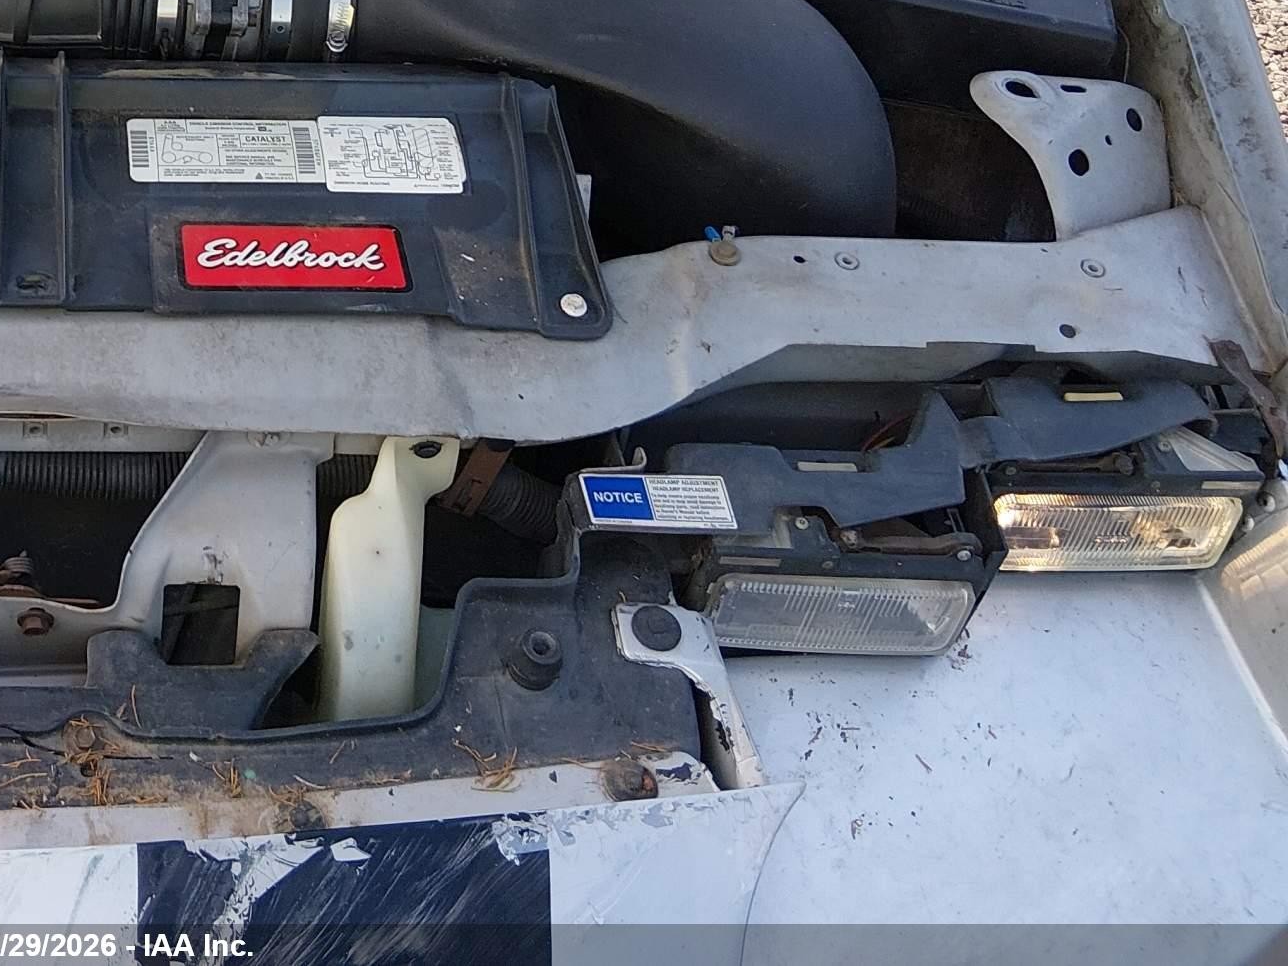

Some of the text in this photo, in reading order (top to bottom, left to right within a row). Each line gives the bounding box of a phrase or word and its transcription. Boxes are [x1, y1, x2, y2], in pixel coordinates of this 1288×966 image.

[244, 135, 287, 143] CATALYST
[195, 237, 386, 272] Edelbrock
[593, 490, 644, 504] NOTICE
